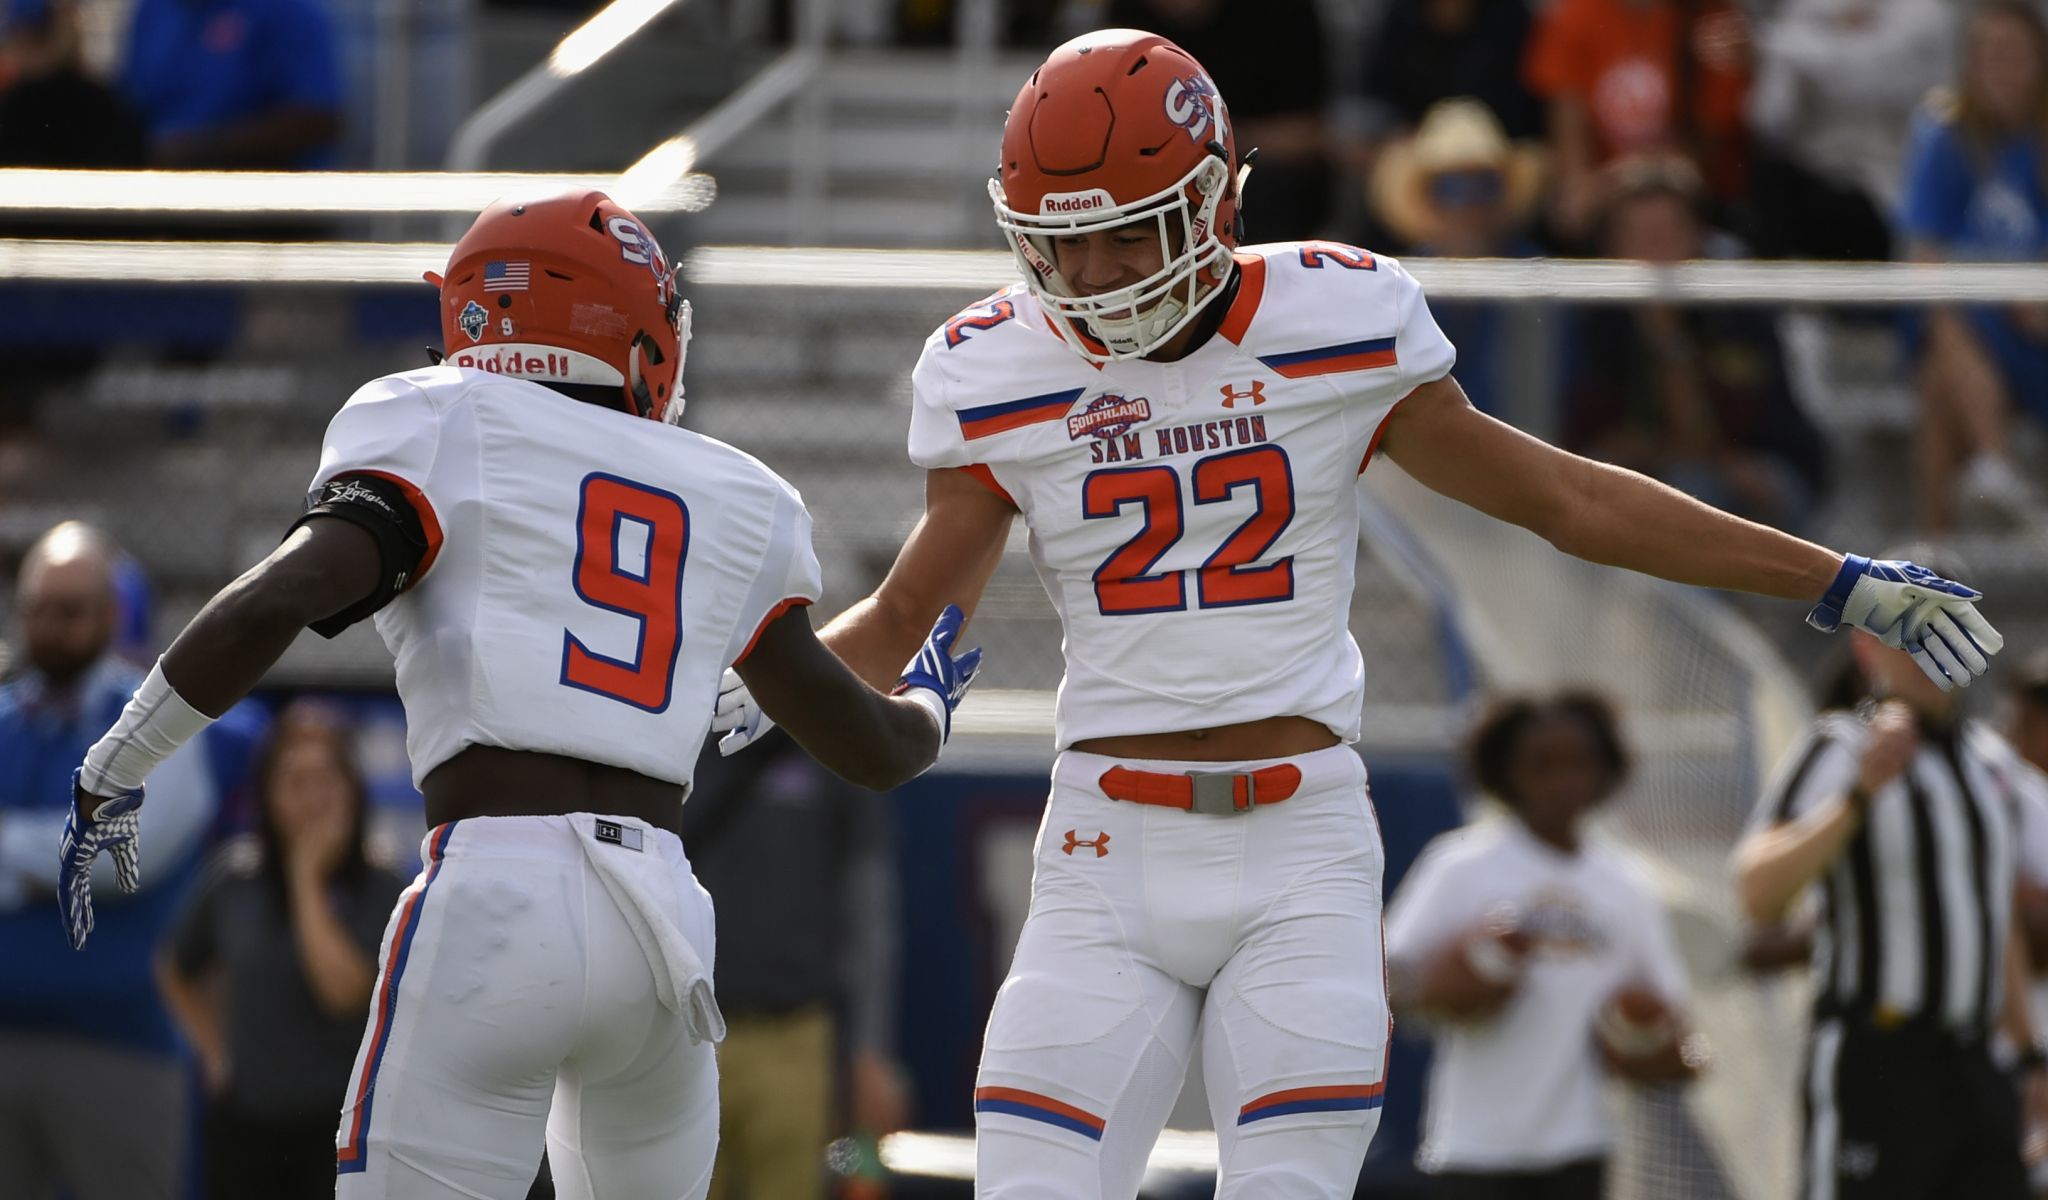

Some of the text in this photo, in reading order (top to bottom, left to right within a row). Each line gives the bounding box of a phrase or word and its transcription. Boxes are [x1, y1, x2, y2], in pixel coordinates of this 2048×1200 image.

[1045, 195, 1103, 212] Riddell
[501, 317, 513, 336] 9
[1069, 399, 1149, 438] SOUTHLAND
[1090, 432, 1143, 464] SAM
[1155, 415, 1268, 456] HOUSTON
[1081, 443, 1296, 616] 22
[559, 471, 690, 715] 9
